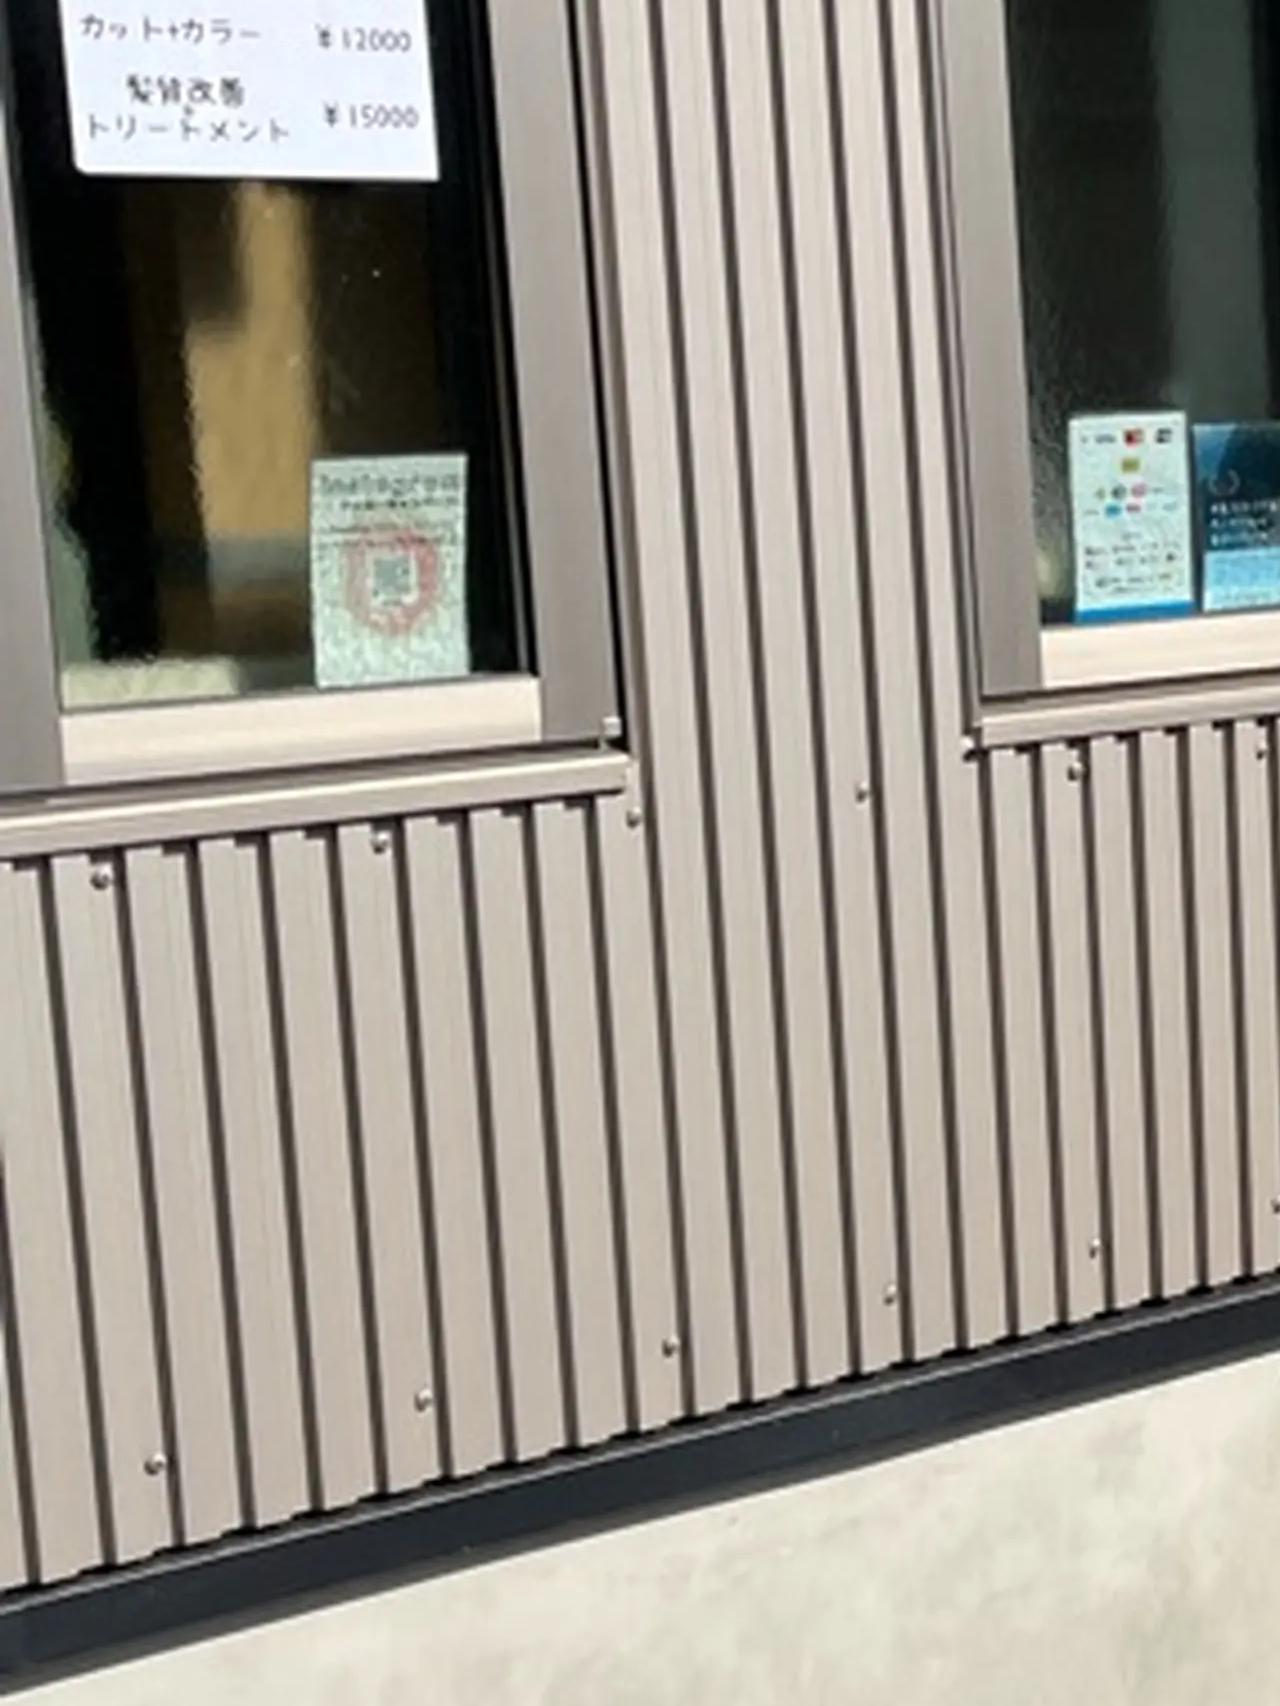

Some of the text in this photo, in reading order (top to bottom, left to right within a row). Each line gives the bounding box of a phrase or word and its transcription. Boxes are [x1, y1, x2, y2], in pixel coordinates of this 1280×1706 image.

[87, 113, 291, 144] トリートメント
